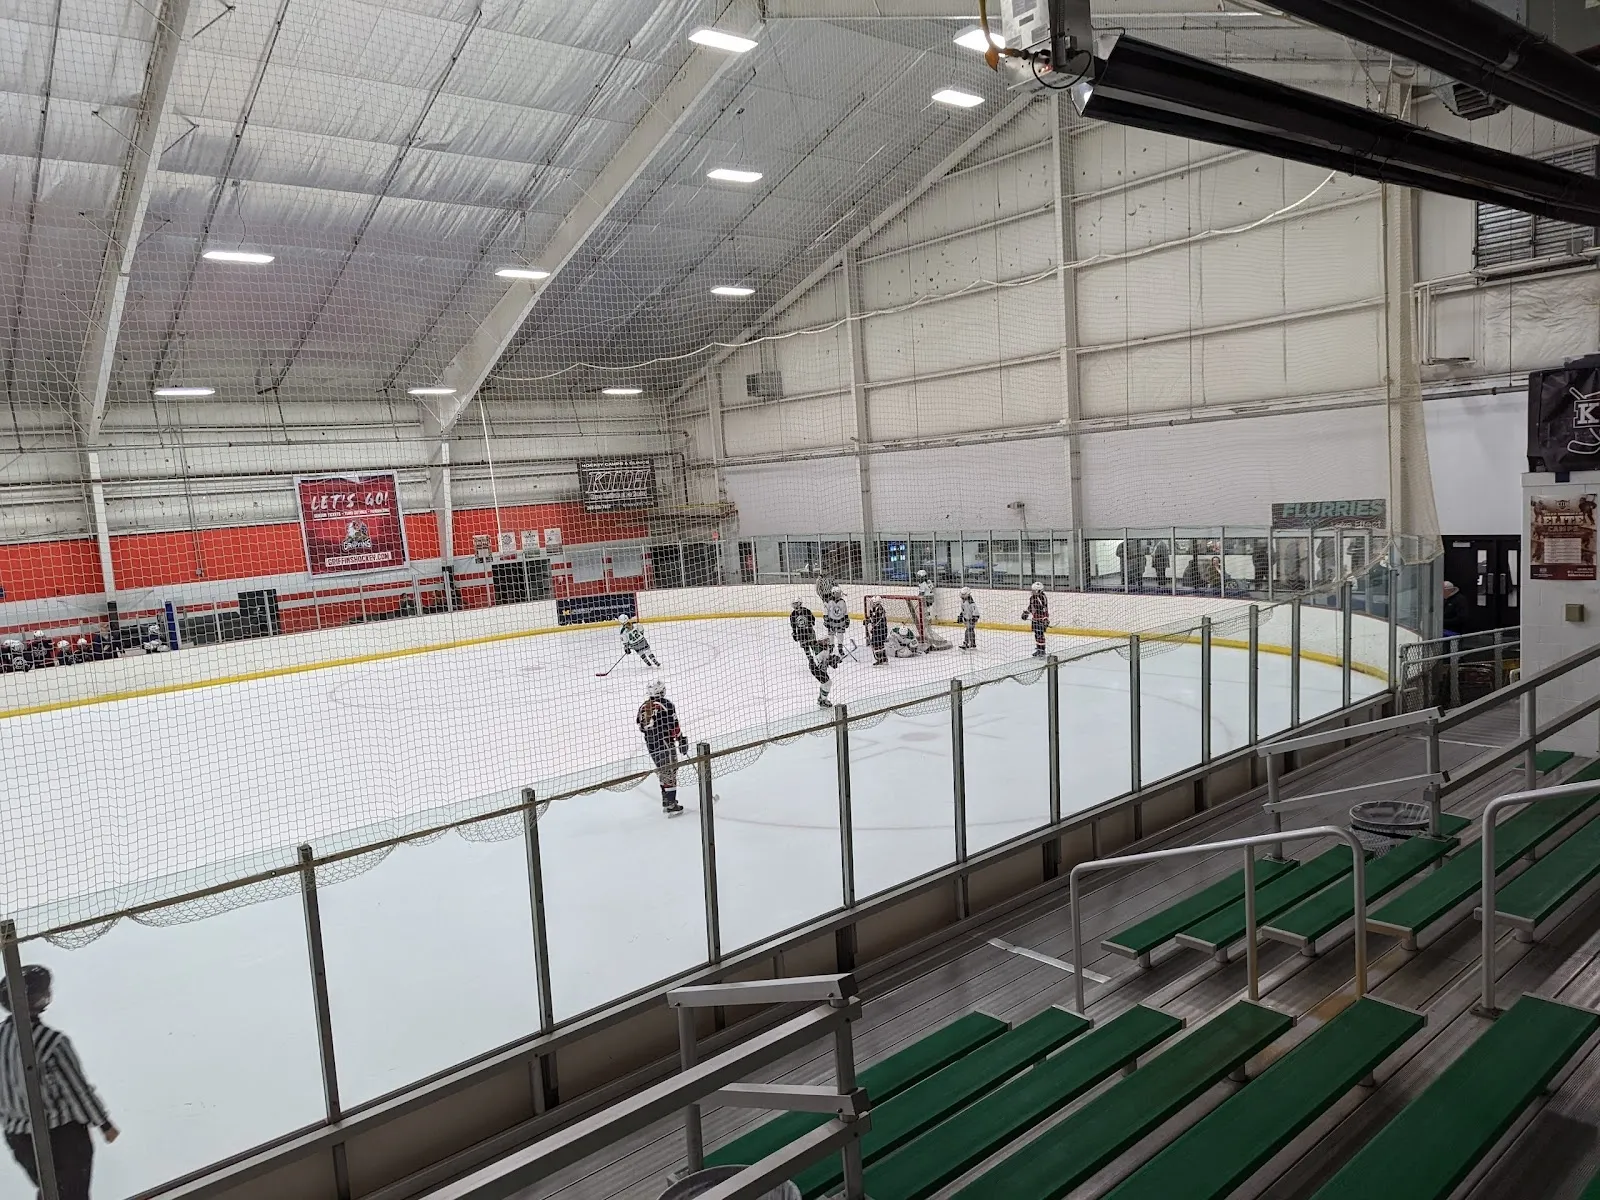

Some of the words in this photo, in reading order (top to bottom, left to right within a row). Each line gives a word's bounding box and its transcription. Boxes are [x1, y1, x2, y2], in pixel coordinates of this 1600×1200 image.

[1577, 402, 1600, 425] K
[310, 493, 356, 511] LET'S
[364, 491, 389, 506] GO!
[1282, 500, 1384, 518] FLURRIES
[1354, 519, 1381, 529] Effect
[1542, 515, 1584, 526] ELITE
